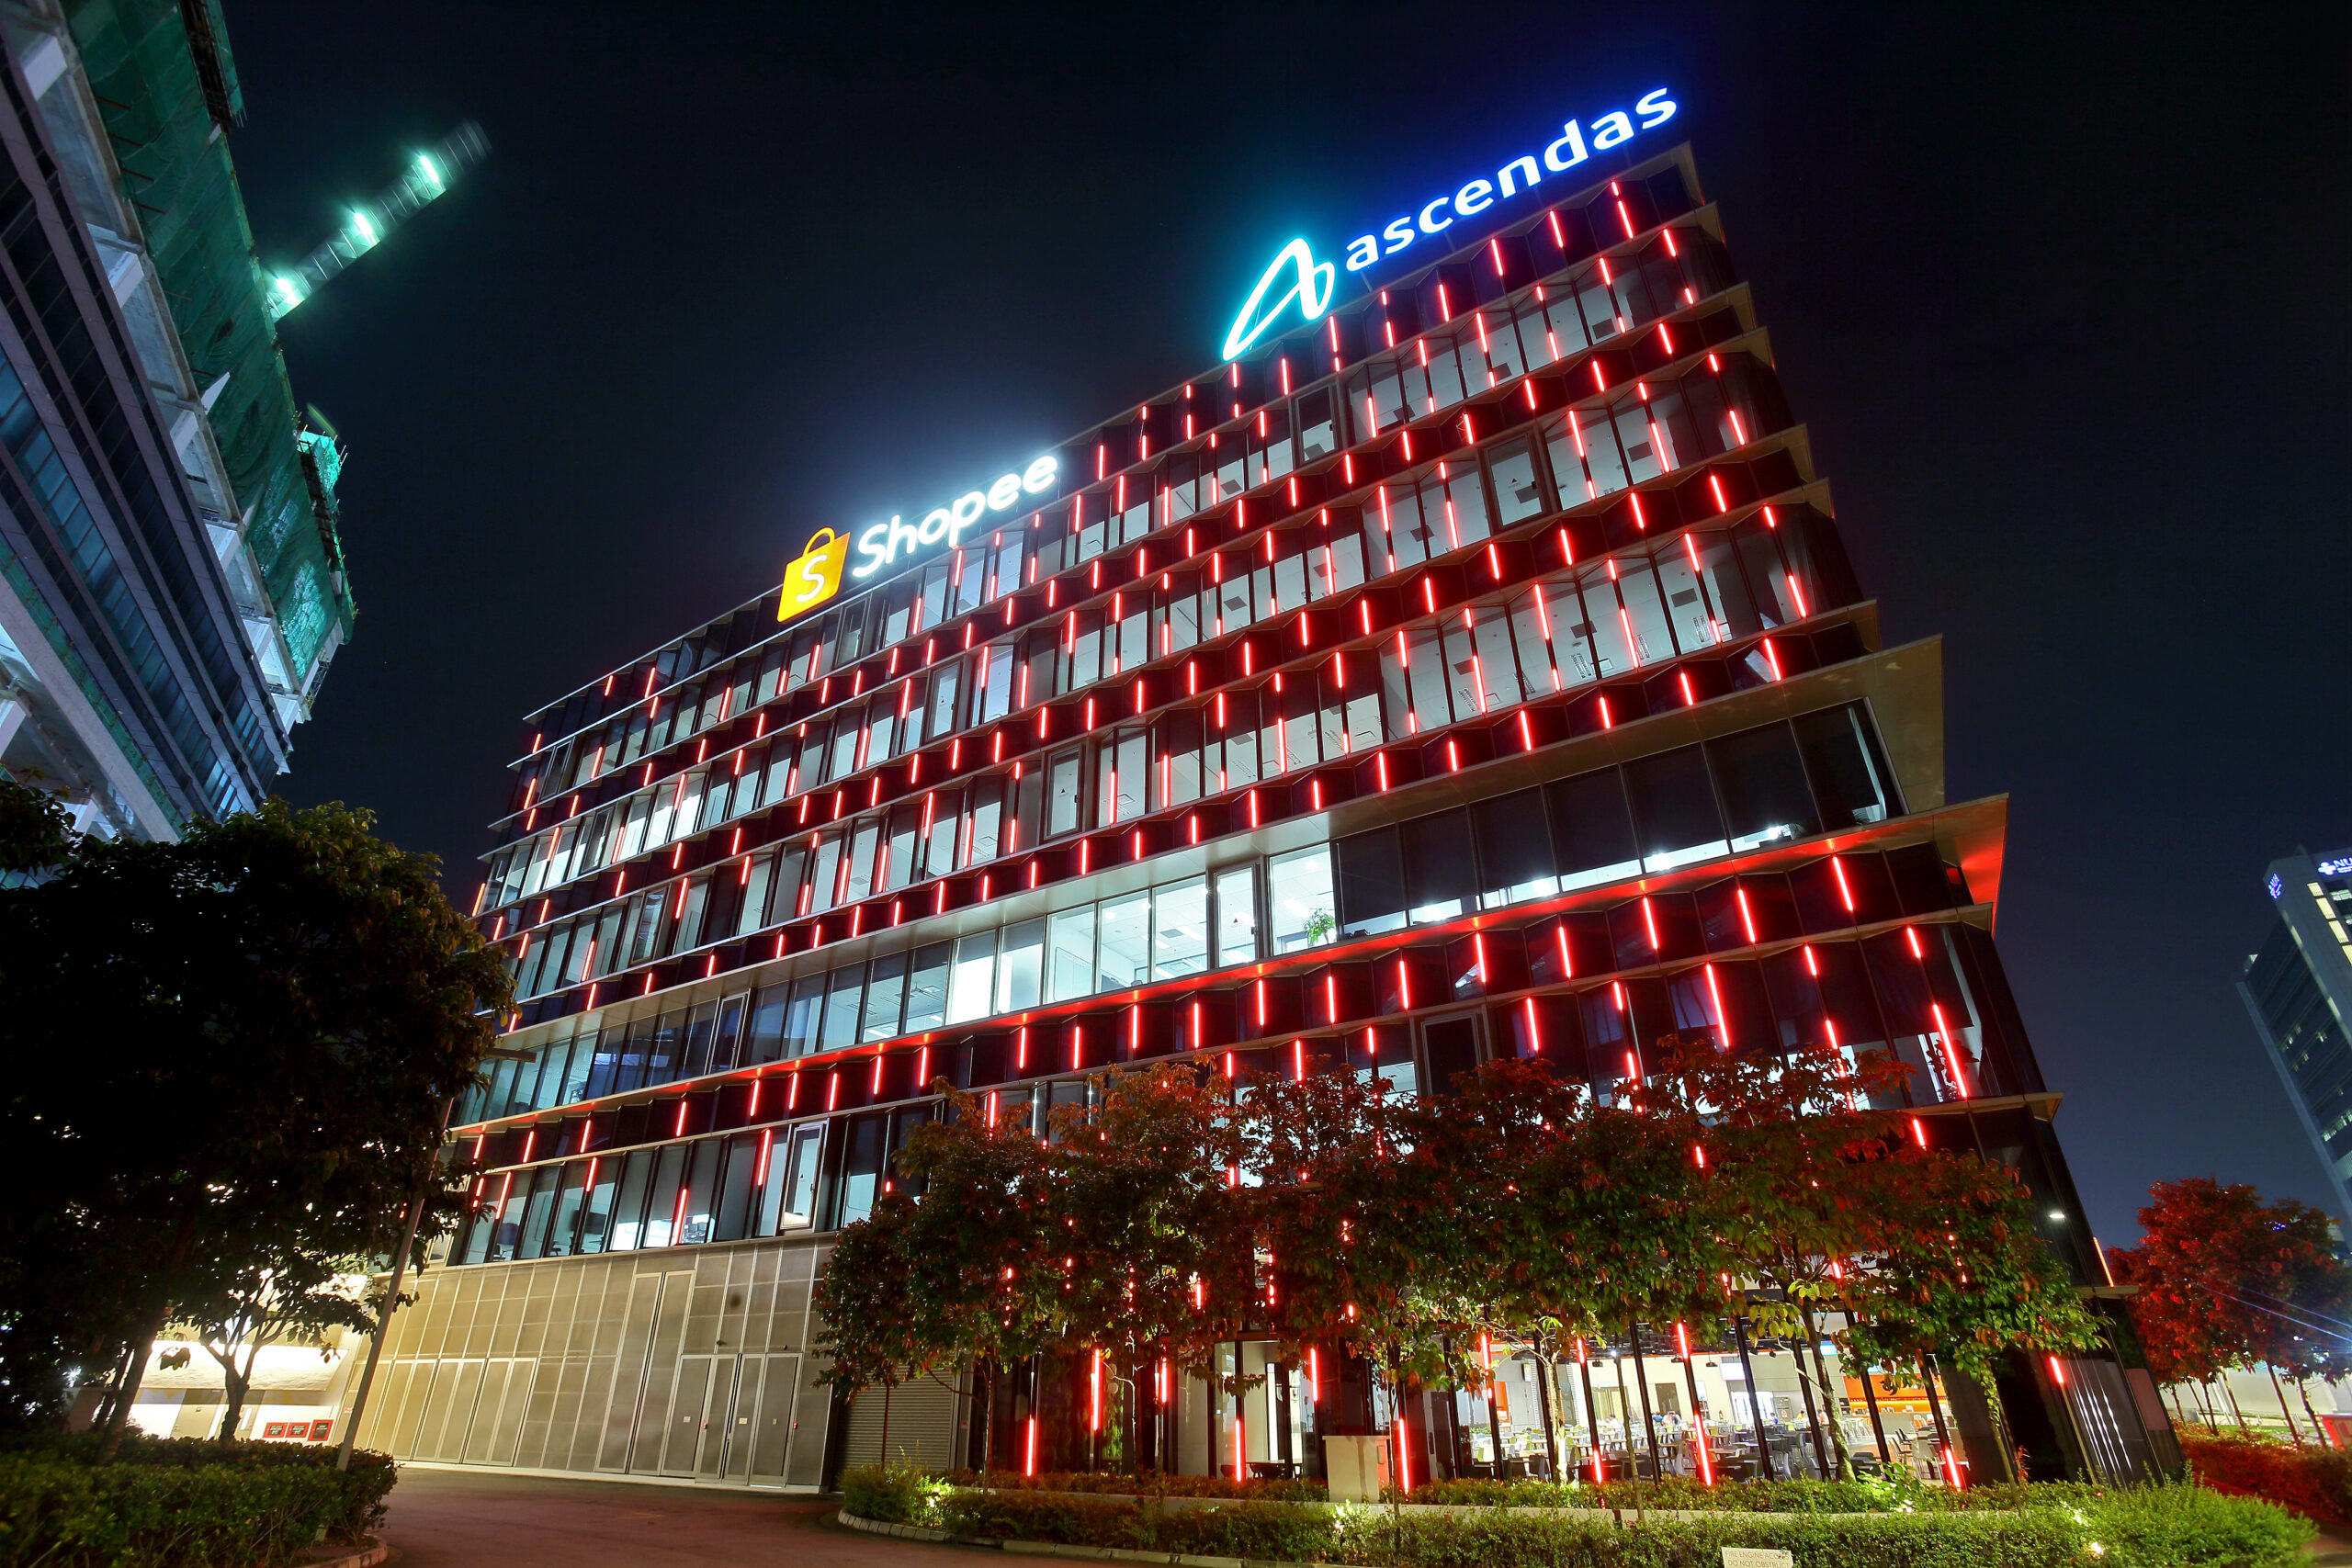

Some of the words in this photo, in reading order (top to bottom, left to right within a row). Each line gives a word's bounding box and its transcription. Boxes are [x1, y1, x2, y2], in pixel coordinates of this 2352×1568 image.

[1345, 86, 1678, 273] ascendas
[796, 554, 828, 603] S
[852, 455, 1058, 579] Shopee
